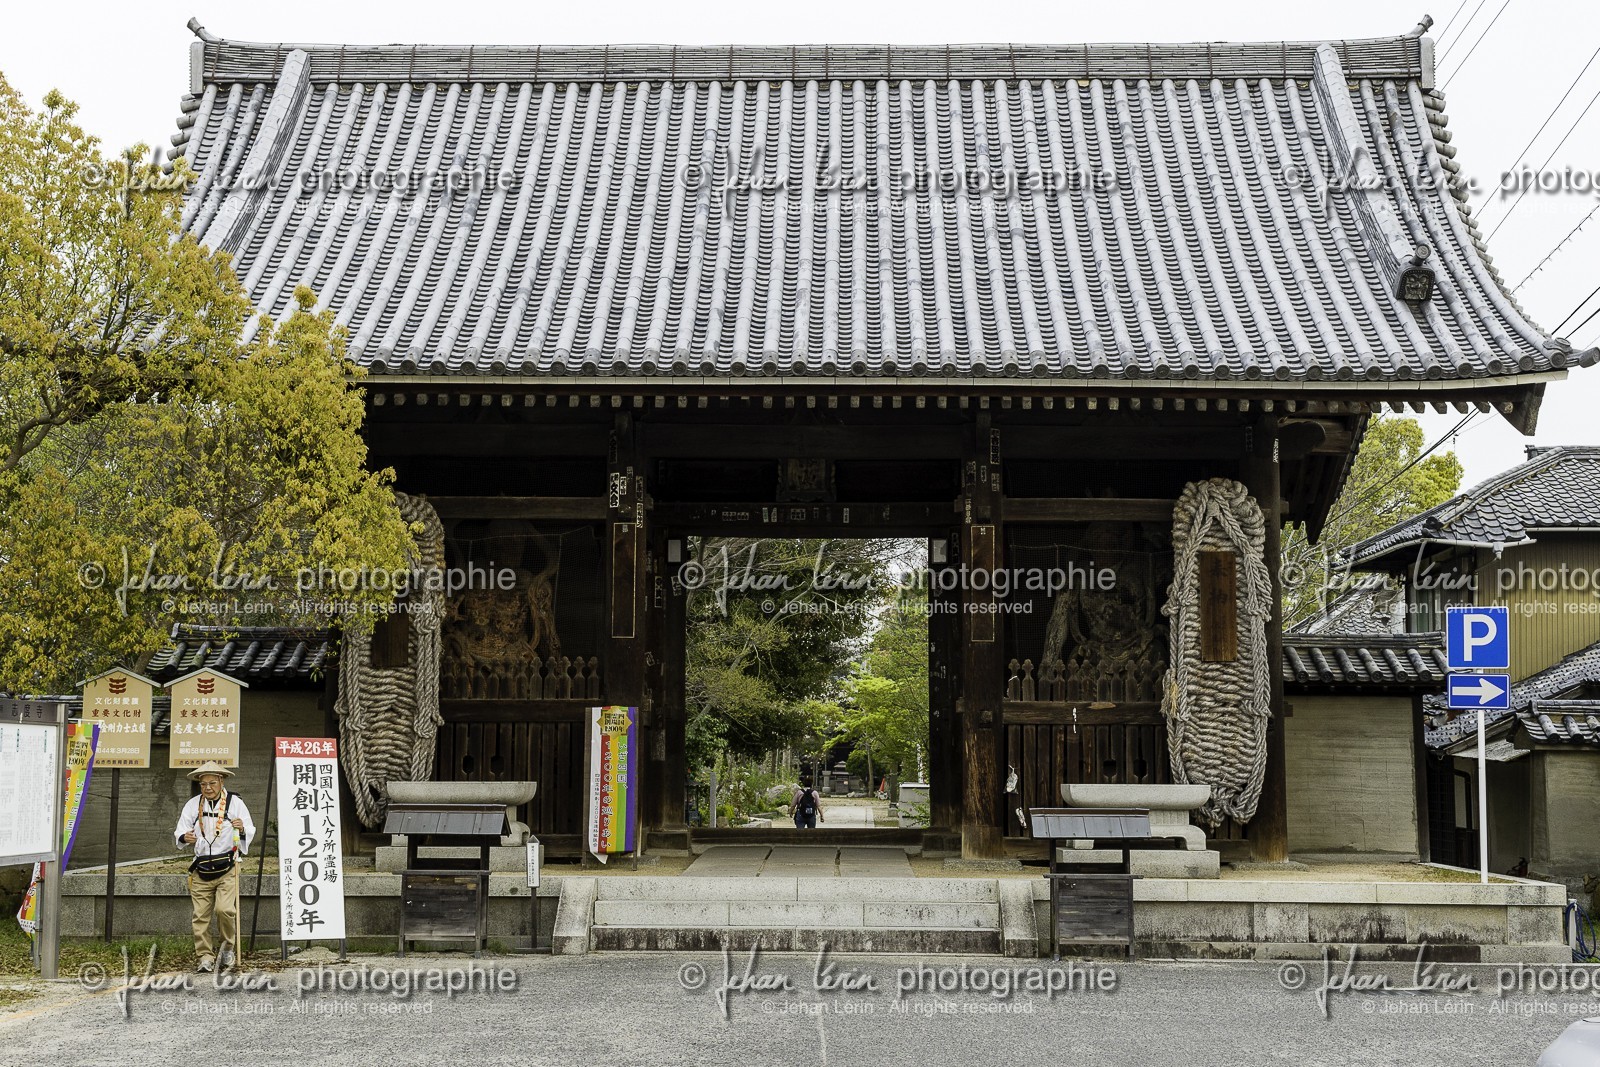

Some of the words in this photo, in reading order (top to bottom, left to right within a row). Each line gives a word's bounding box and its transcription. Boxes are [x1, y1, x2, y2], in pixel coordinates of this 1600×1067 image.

[1464, 613, 1497, 661] P
[92, 709, 141, 717] 重要文化財
[180, 709, 230, 717] 重要文化財
[174, 722, 236, 734] 志度寺仁王門
[278, 740, 335, 756] 平成26年
[292, 763, 325, 933] 開創1200年
